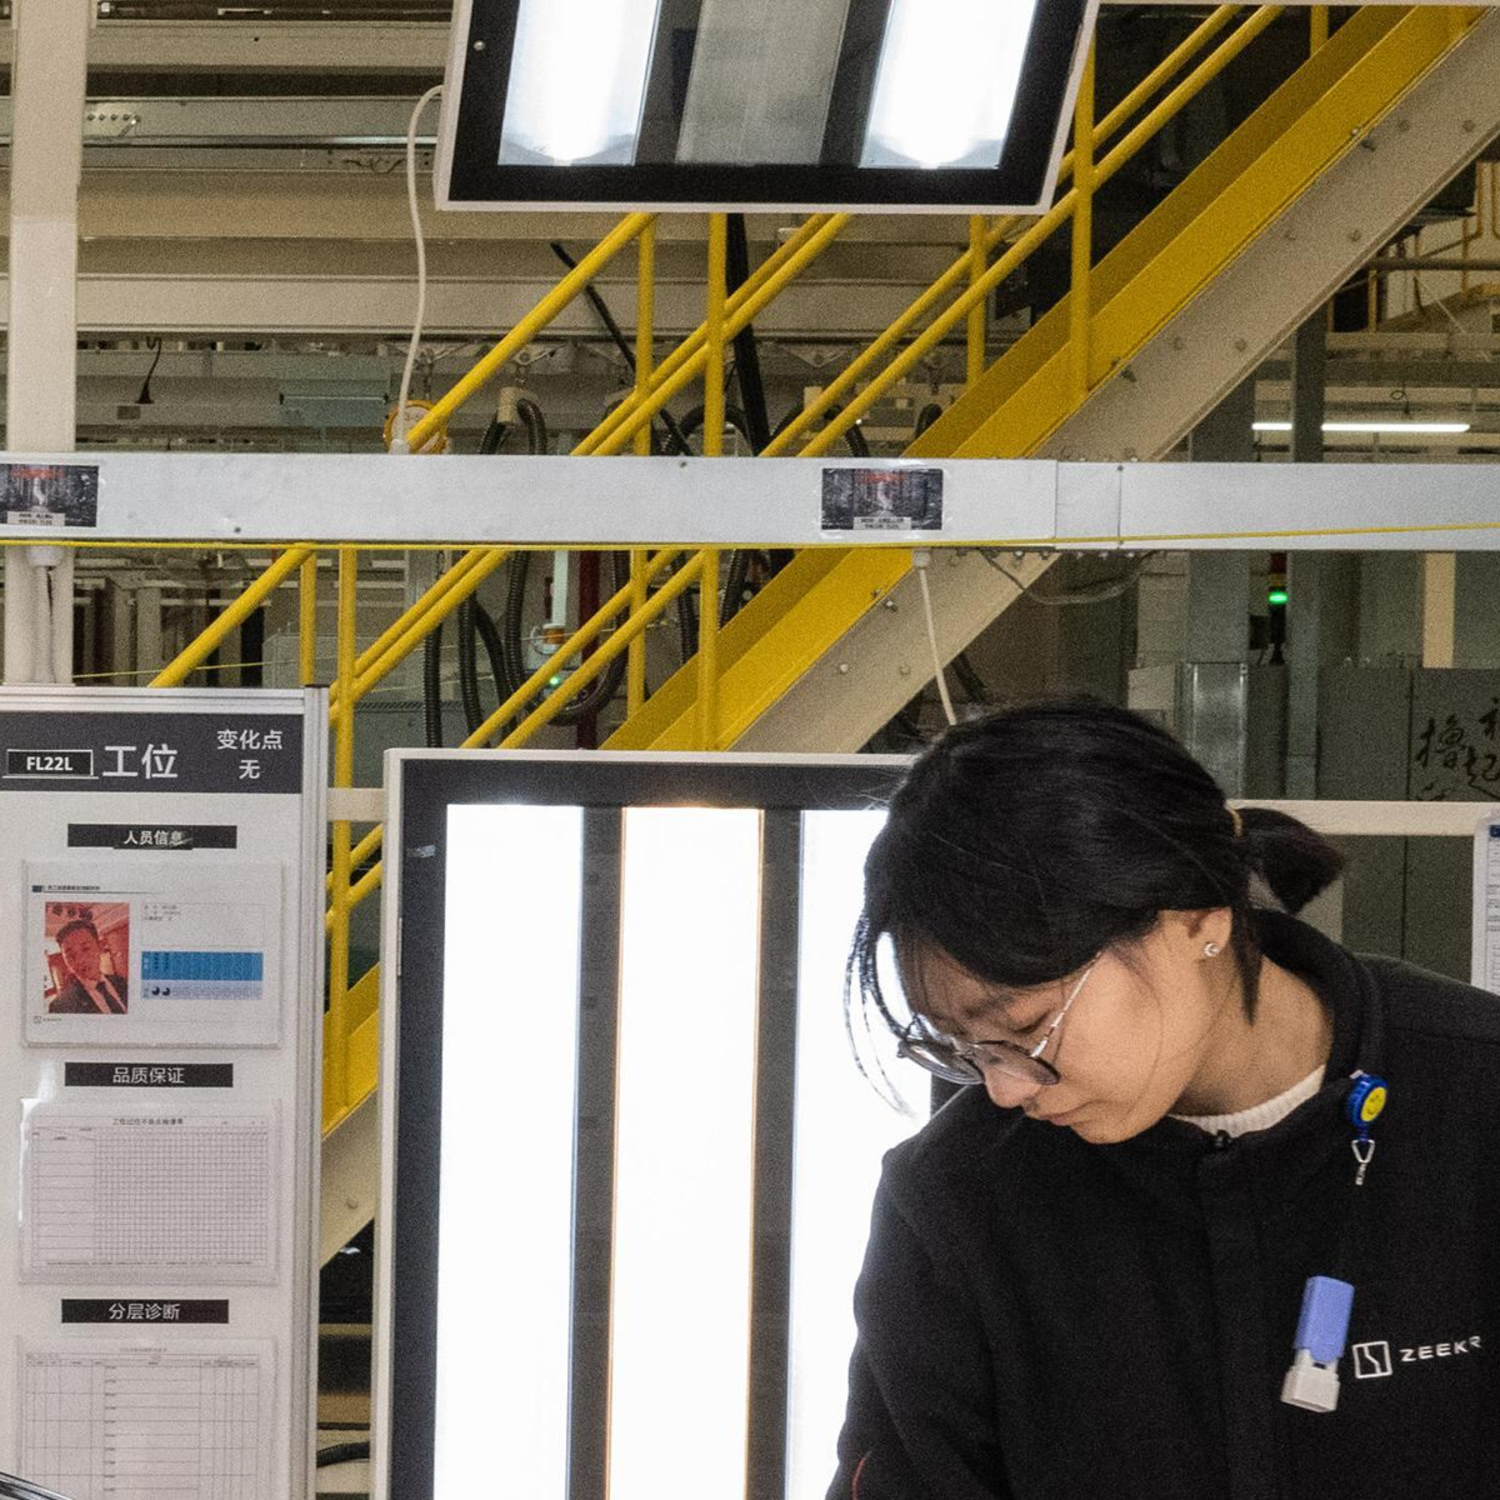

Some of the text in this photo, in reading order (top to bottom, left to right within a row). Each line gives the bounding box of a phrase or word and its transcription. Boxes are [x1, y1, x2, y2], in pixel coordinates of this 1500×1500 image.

[216, 729, 283, 750] 变化点
[26, 756, 73, 771] FL22L
[102, 743, 178, 779] 工位
[238, 759, 260, 779] 无
[123, 830, 184, 846] 人员信息
[112, 1067, 185, 1084] 品质保证
[108, 1303, 180, 1320] 分层诊断
[1400, 1335, 1482, 1362] ZEEKR
